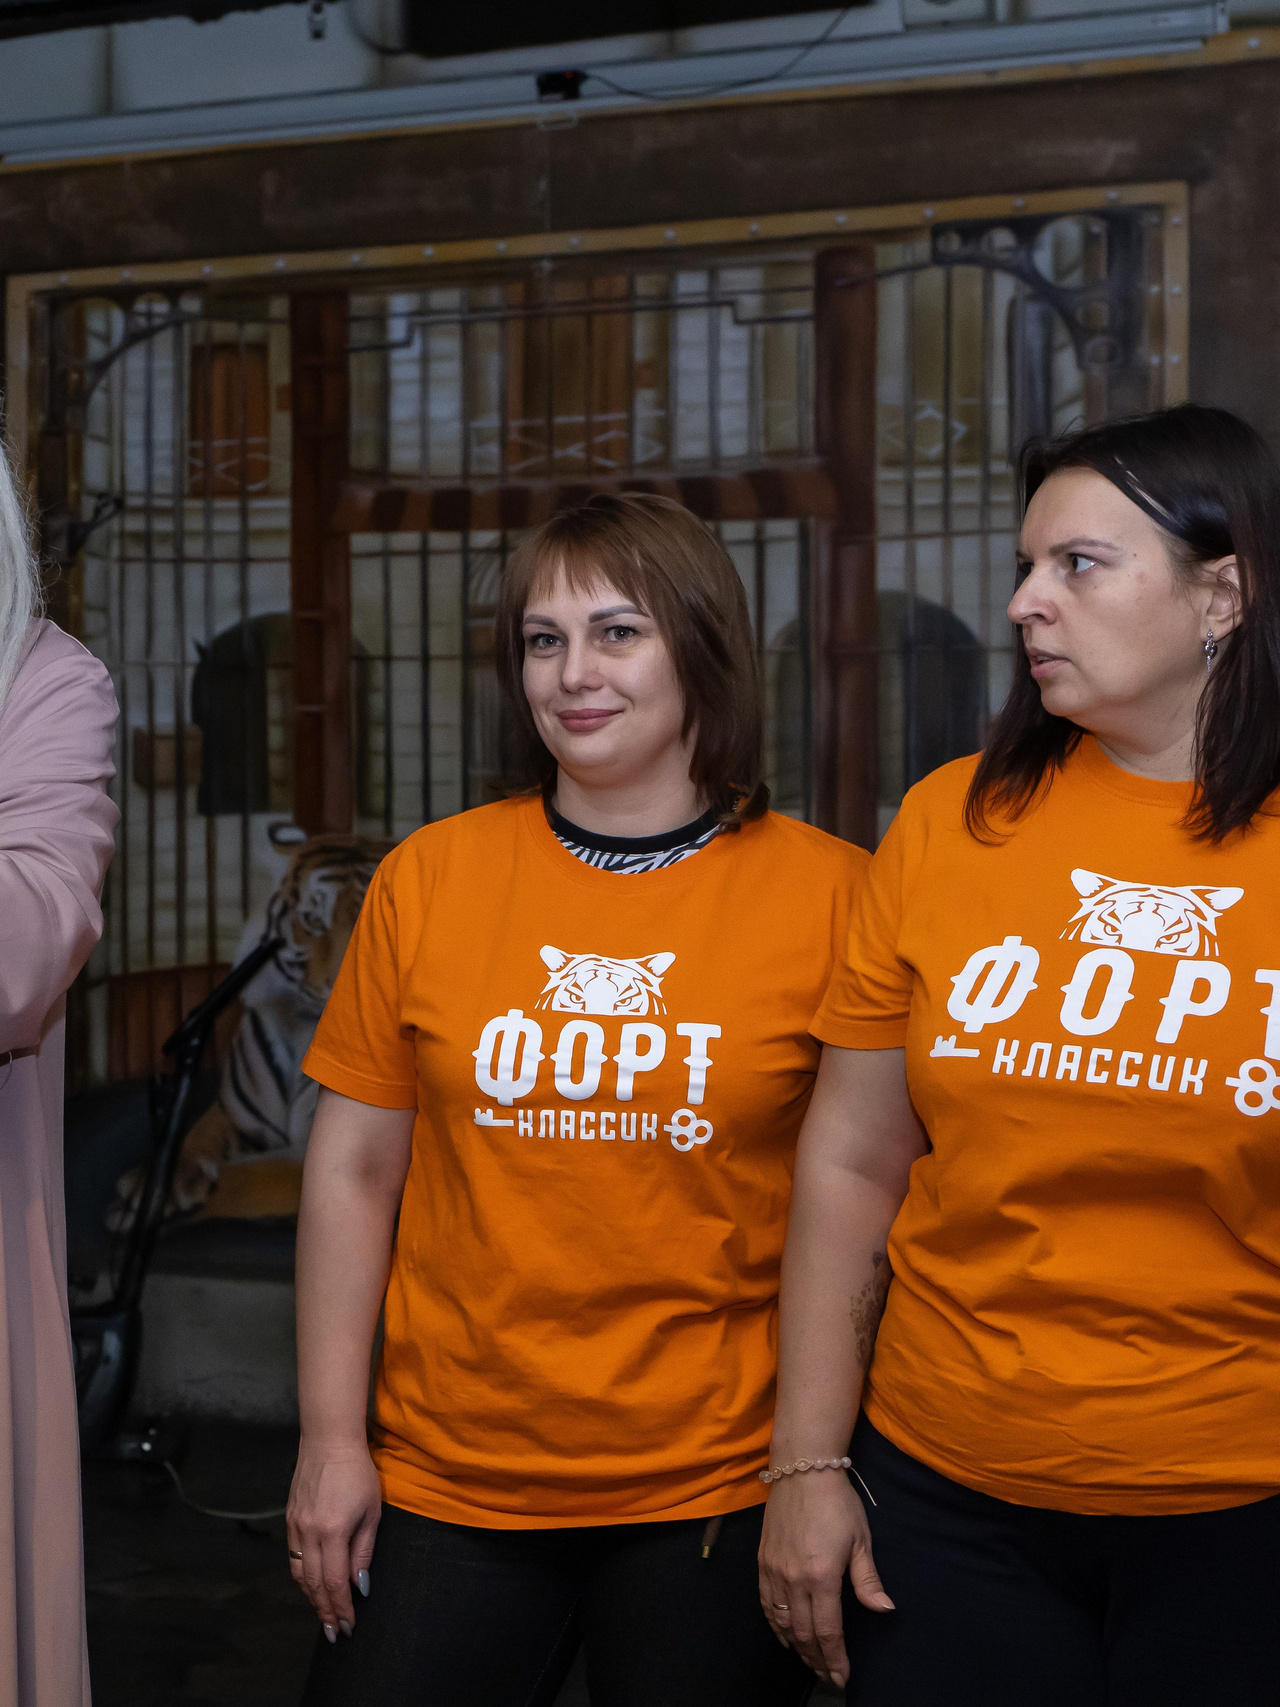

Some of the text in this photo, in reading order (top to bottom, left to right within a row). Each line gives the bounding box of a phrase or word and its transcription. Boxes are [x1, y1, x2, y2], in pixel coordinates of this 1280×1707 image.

[472, 1009, 722, 1106] ФОРТ
[992, 1038, 1208, 1095] КЛАССИК
[518, 1109, 658, 1141] КЛАССИК
